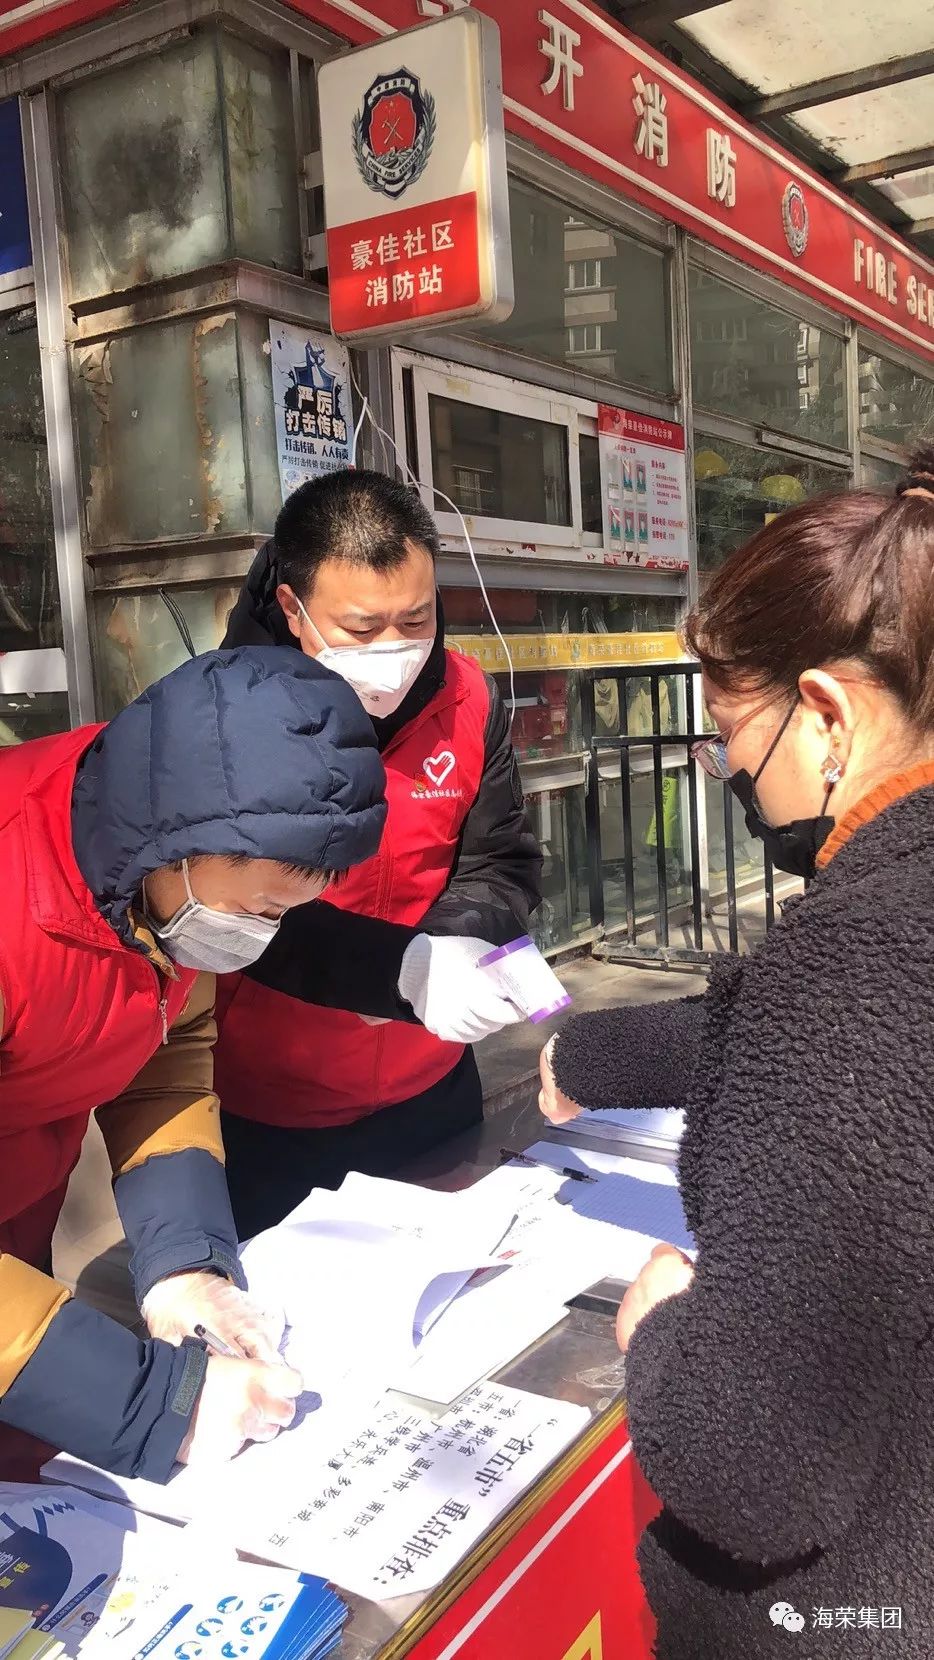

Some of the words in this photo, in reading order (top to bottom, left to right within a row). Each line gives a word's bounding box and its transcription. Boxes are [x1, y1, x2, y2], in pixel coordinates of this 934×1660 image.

[350, 220, 455, 271] 豪佳社区
[365, 264, 443, 307] 消防站
[854, 238, 898, 305] FIRE
[297, 385, 334, 418] 严厉
[285, 409, 348, 445] 打击传销
